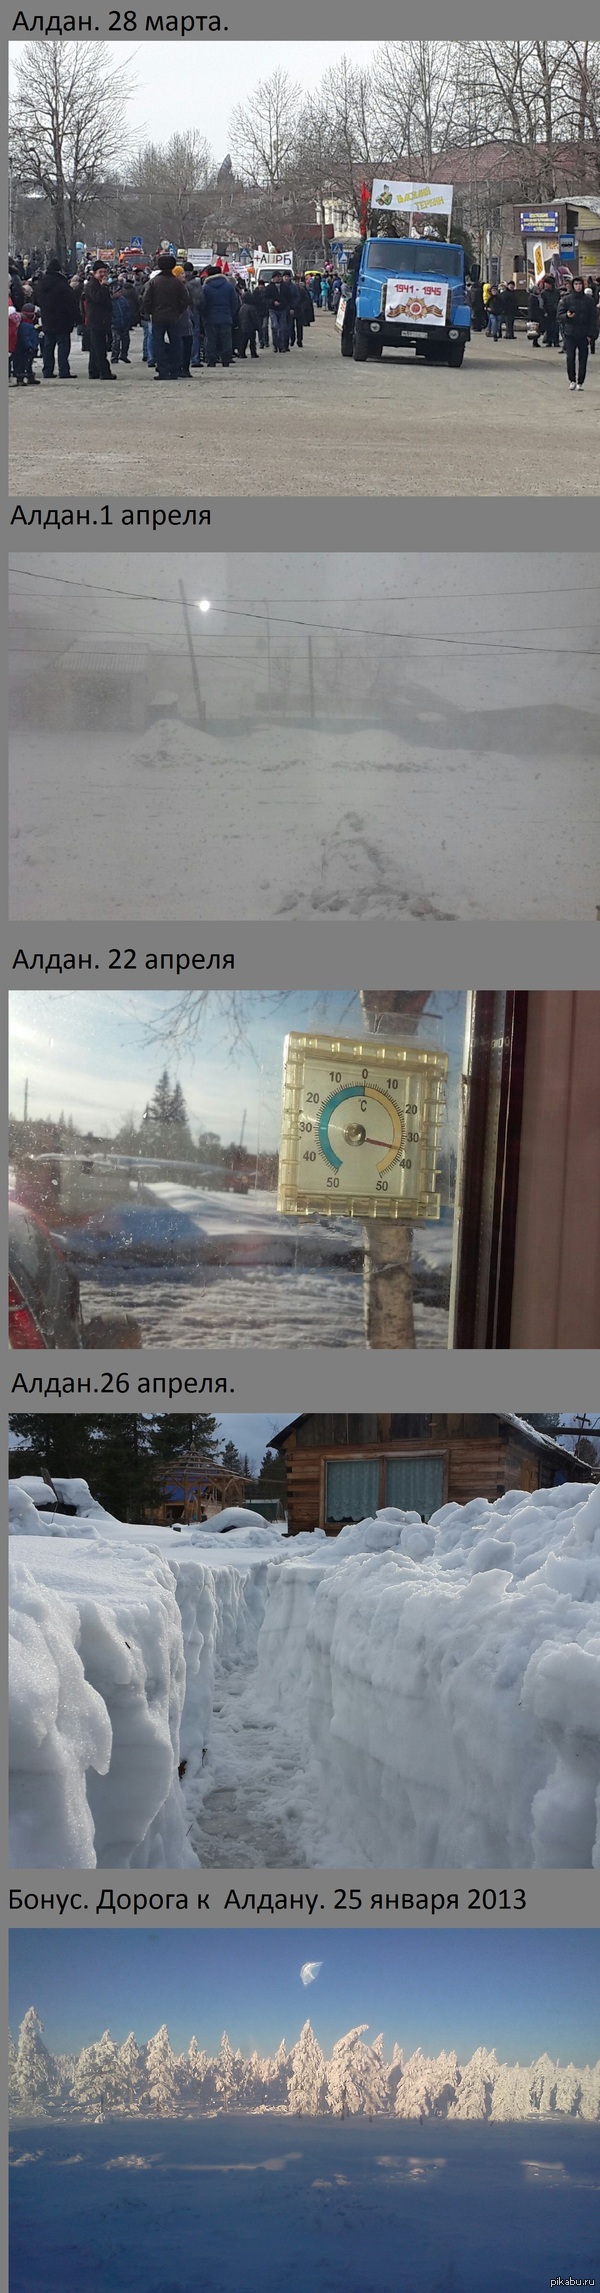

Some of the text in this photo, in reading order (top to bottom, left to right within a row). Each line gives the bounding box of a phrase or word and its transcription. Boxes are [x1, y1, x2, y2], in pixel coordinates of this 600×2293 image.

[394, 283, 414, 294] 1941
[422, 285, 442, 296] 1945
[329, 1071, 342, 1083] 10
[362, 1068, 369, 1080] 0
[386, 1078, 398, 1090] 10
[306, 1092, 320, 1104] 20
[405, 1104, 418, 1115] 20
[300, 1121, 312, 1133] 30
[407, 1132, 419, 1143] 30
[303, 1150, 316, 1162] 40
[399, 1158, 412, 1169] 40
[326, 1177, 340, 1188] 50
[376, 1180, 389, 1191] 50
